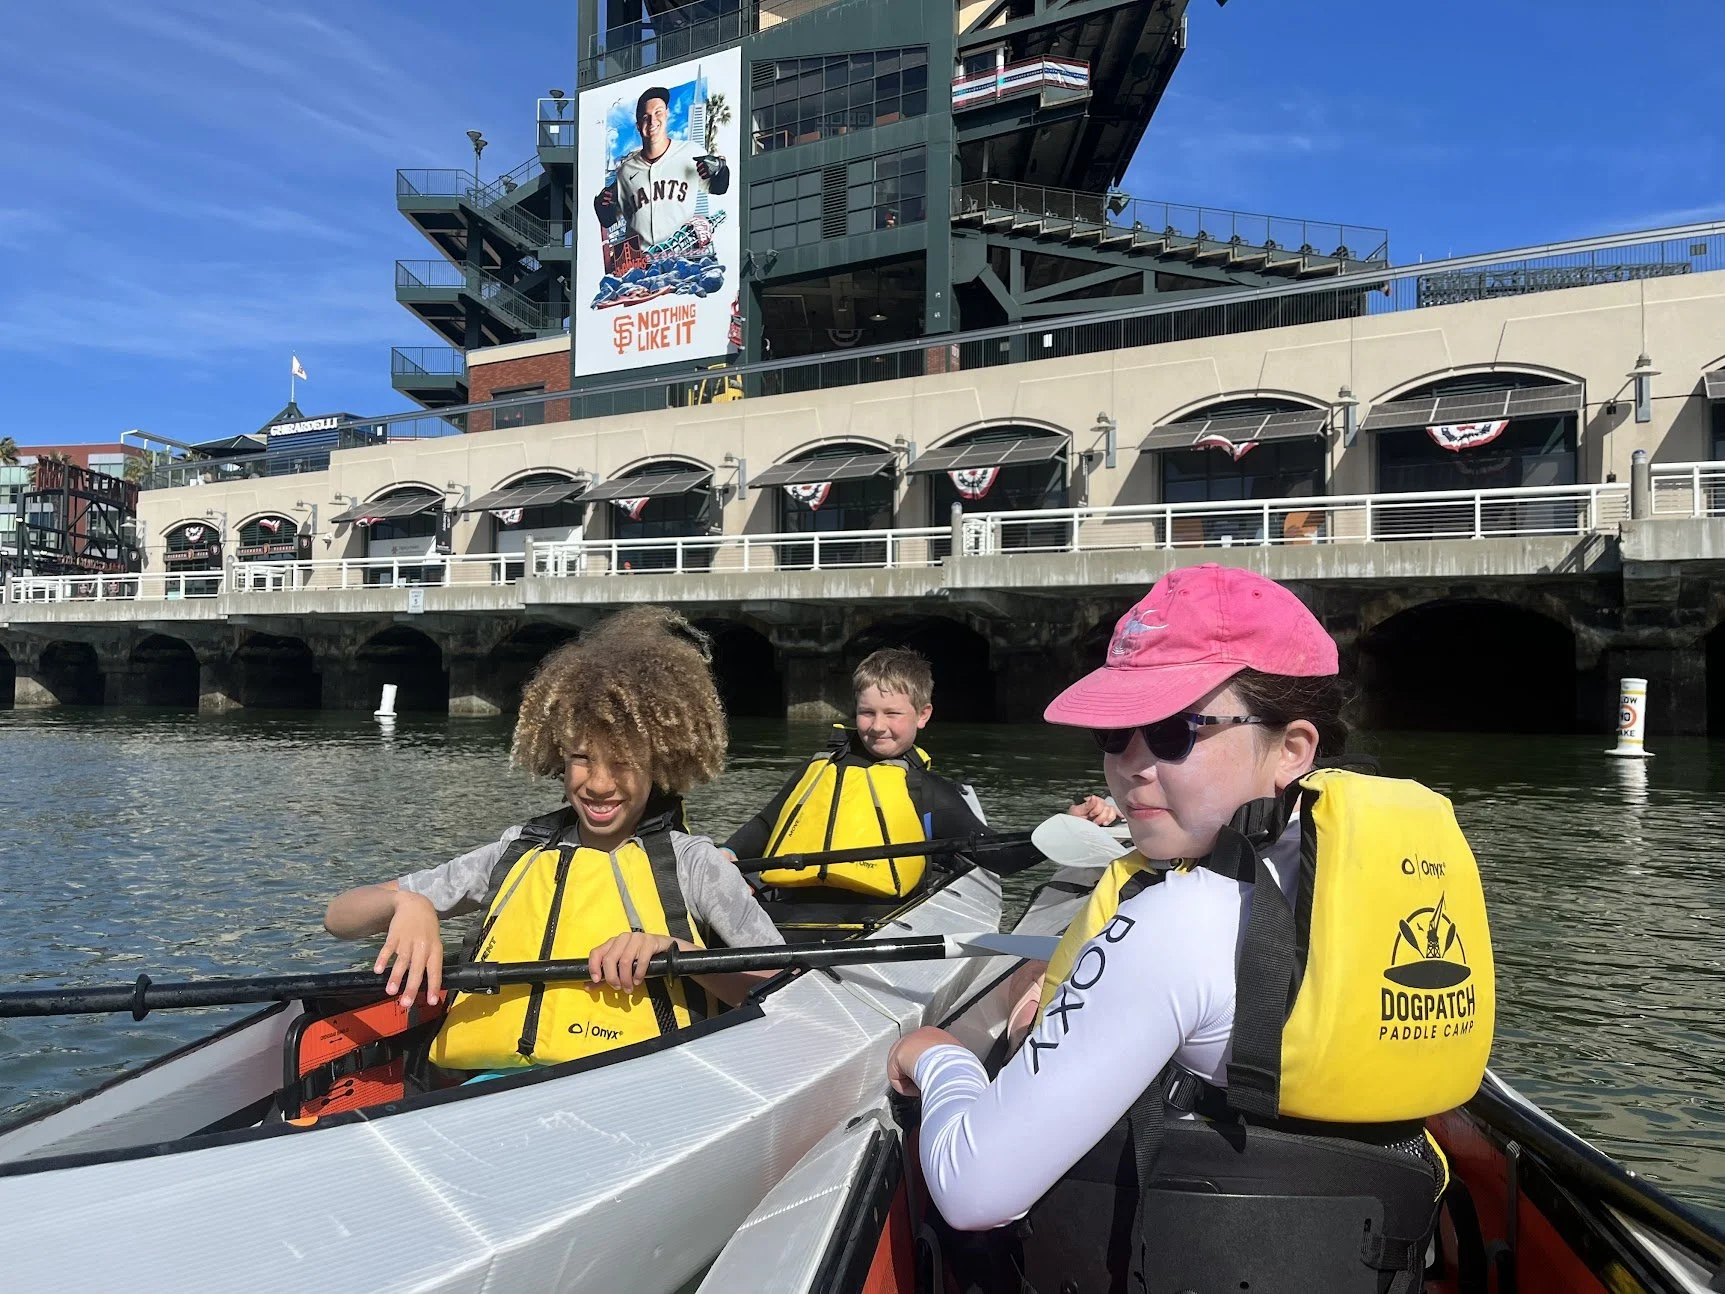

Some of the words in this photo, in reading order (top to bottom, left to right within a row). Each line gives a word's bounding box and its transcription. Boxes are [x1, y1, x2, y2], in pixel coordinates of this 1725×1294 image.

[637, 303, 697, 332] NOTHING
[613, 314, 635, 355] SF
[637, 326, 671, 352] LIKE
[676, 319, 696, 346] IT
[1421, 858, 1446, 879] Onyx
[1028, 914, 1137, 1076] ROXY
[1381, 984, 1476, 1021] DOGPATCH
[591, 1025, 618, 1040] Onyx
[1379, 1024, 1437, 1040] PADDLE
[1443, 1020, 1475, 1036] CAMP
